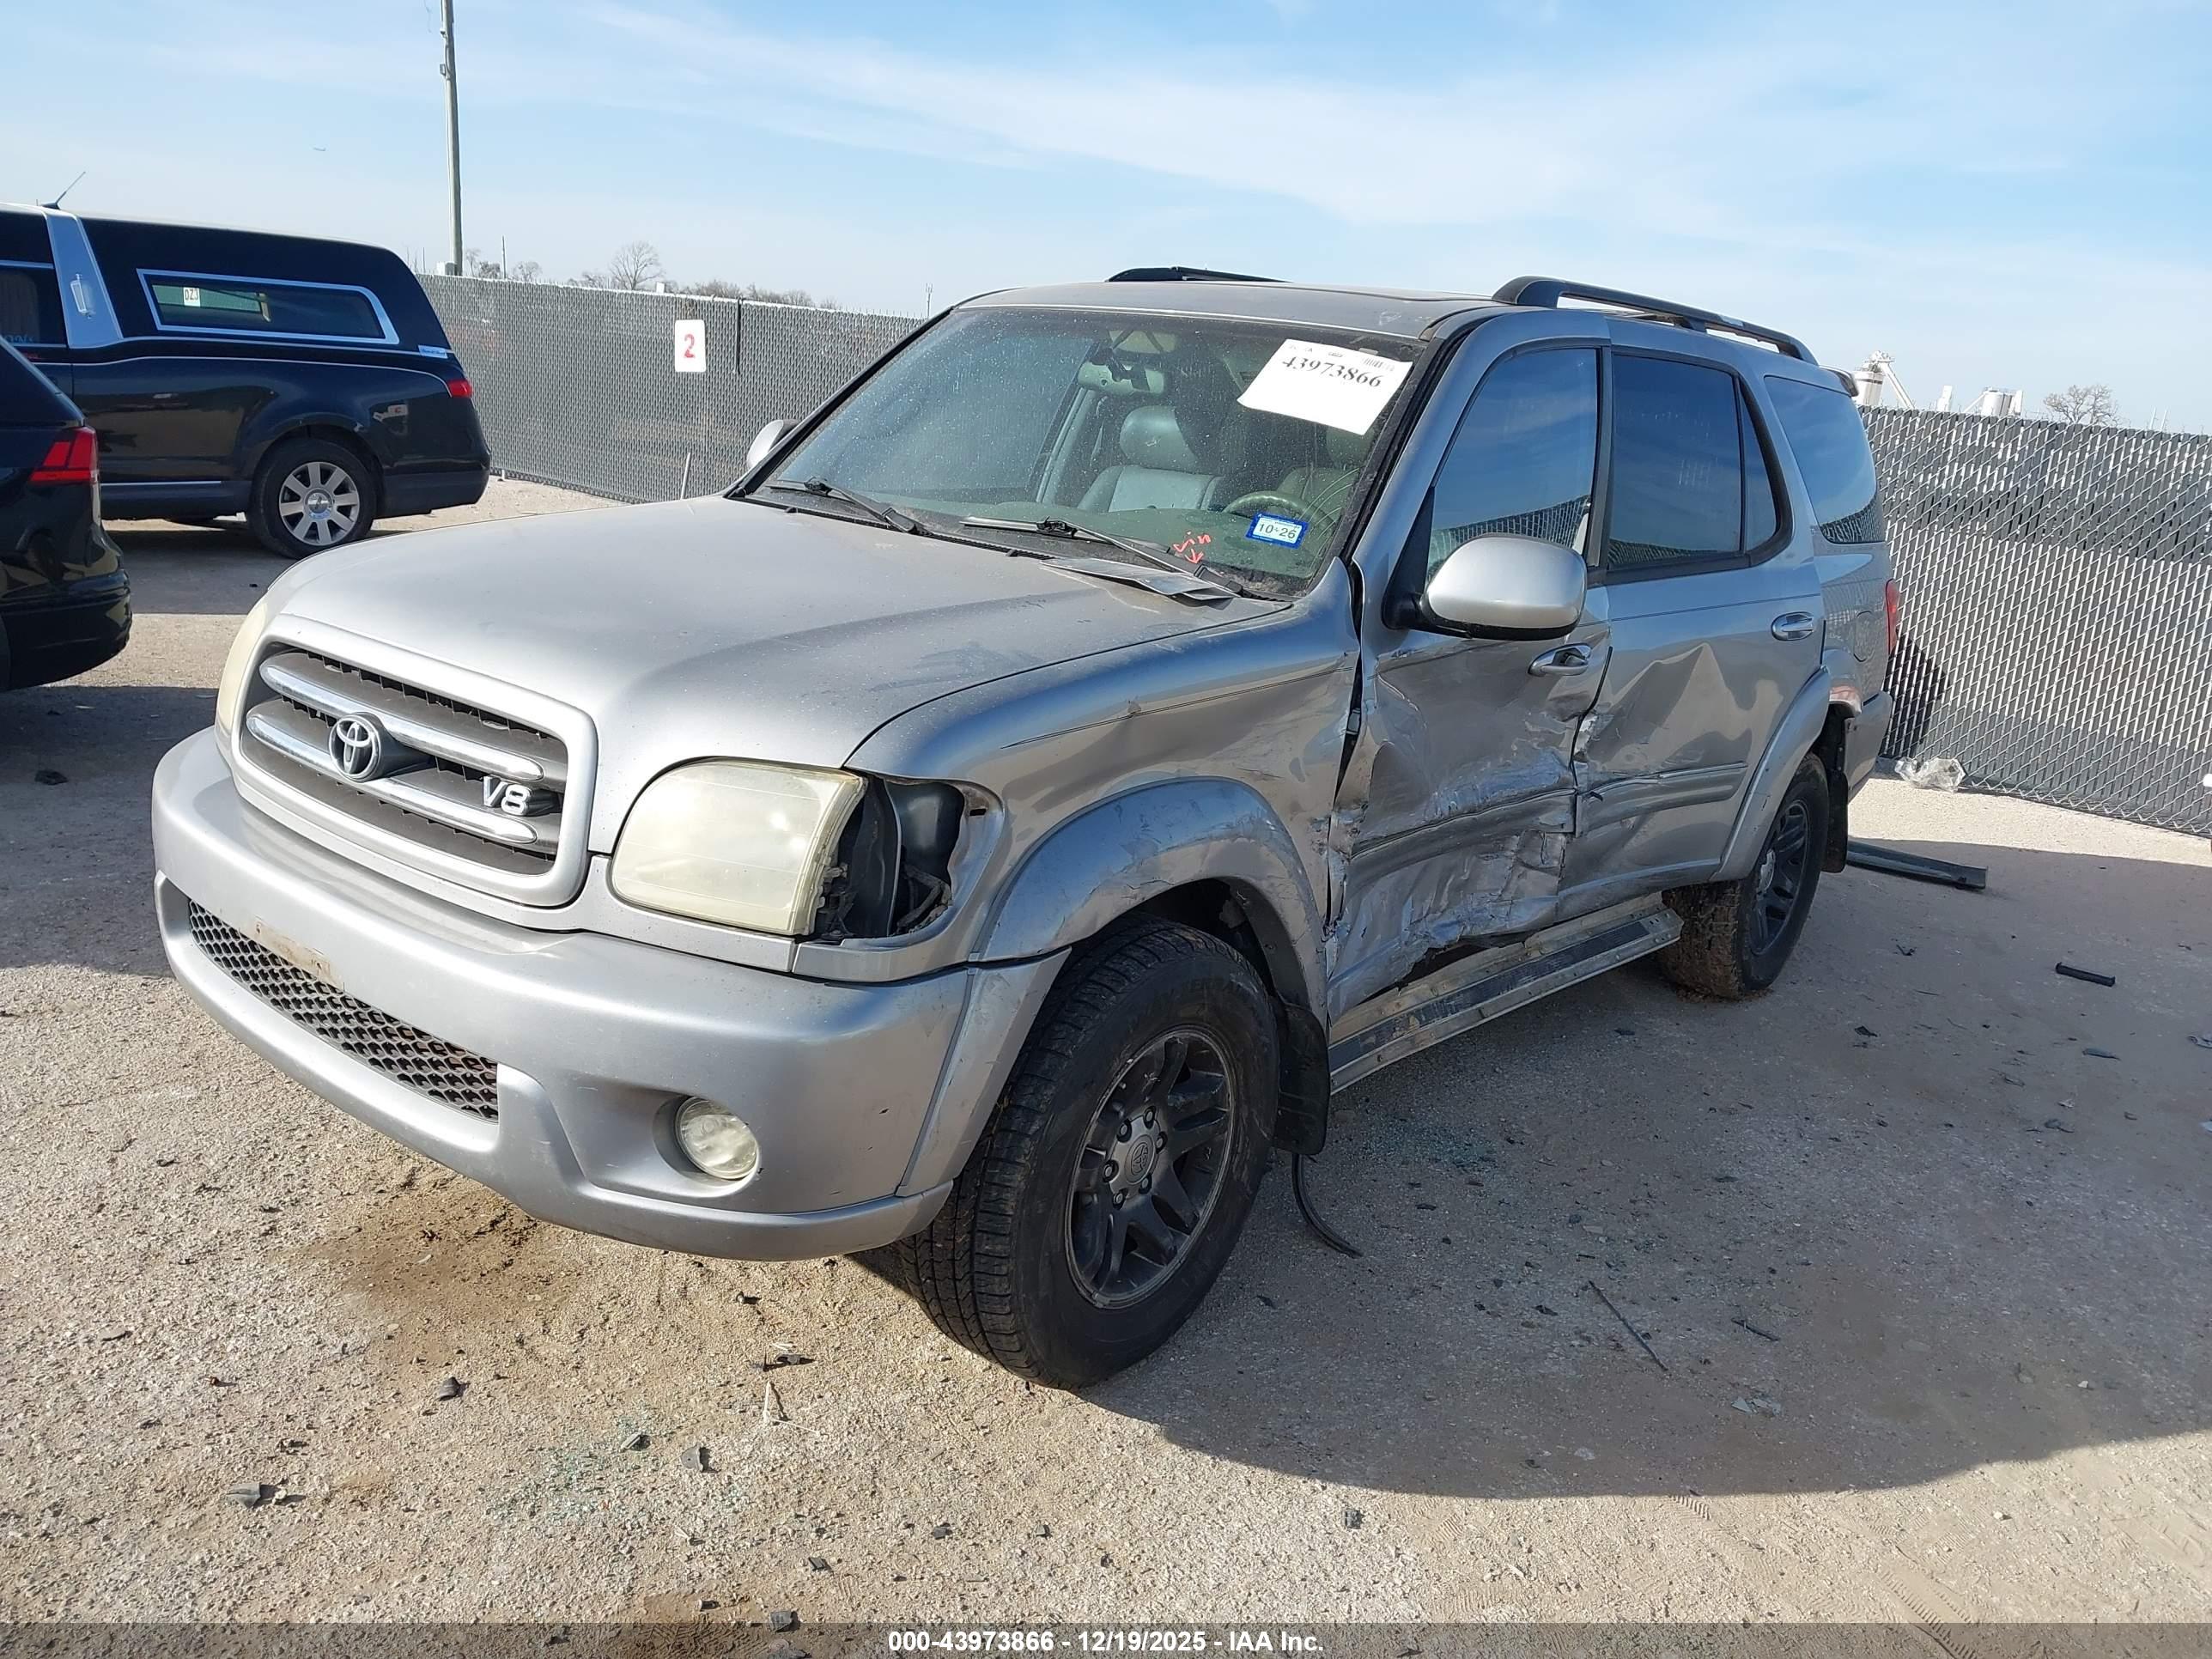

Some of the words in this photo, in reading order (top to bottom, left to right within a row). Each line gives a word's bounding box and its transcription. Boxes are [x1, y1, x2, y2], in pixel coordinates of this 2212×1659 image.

[684, 333, 695, 358] 2
[1282, 356, 1383, 387] 43973866
[483, 775, 532, 816] V8
